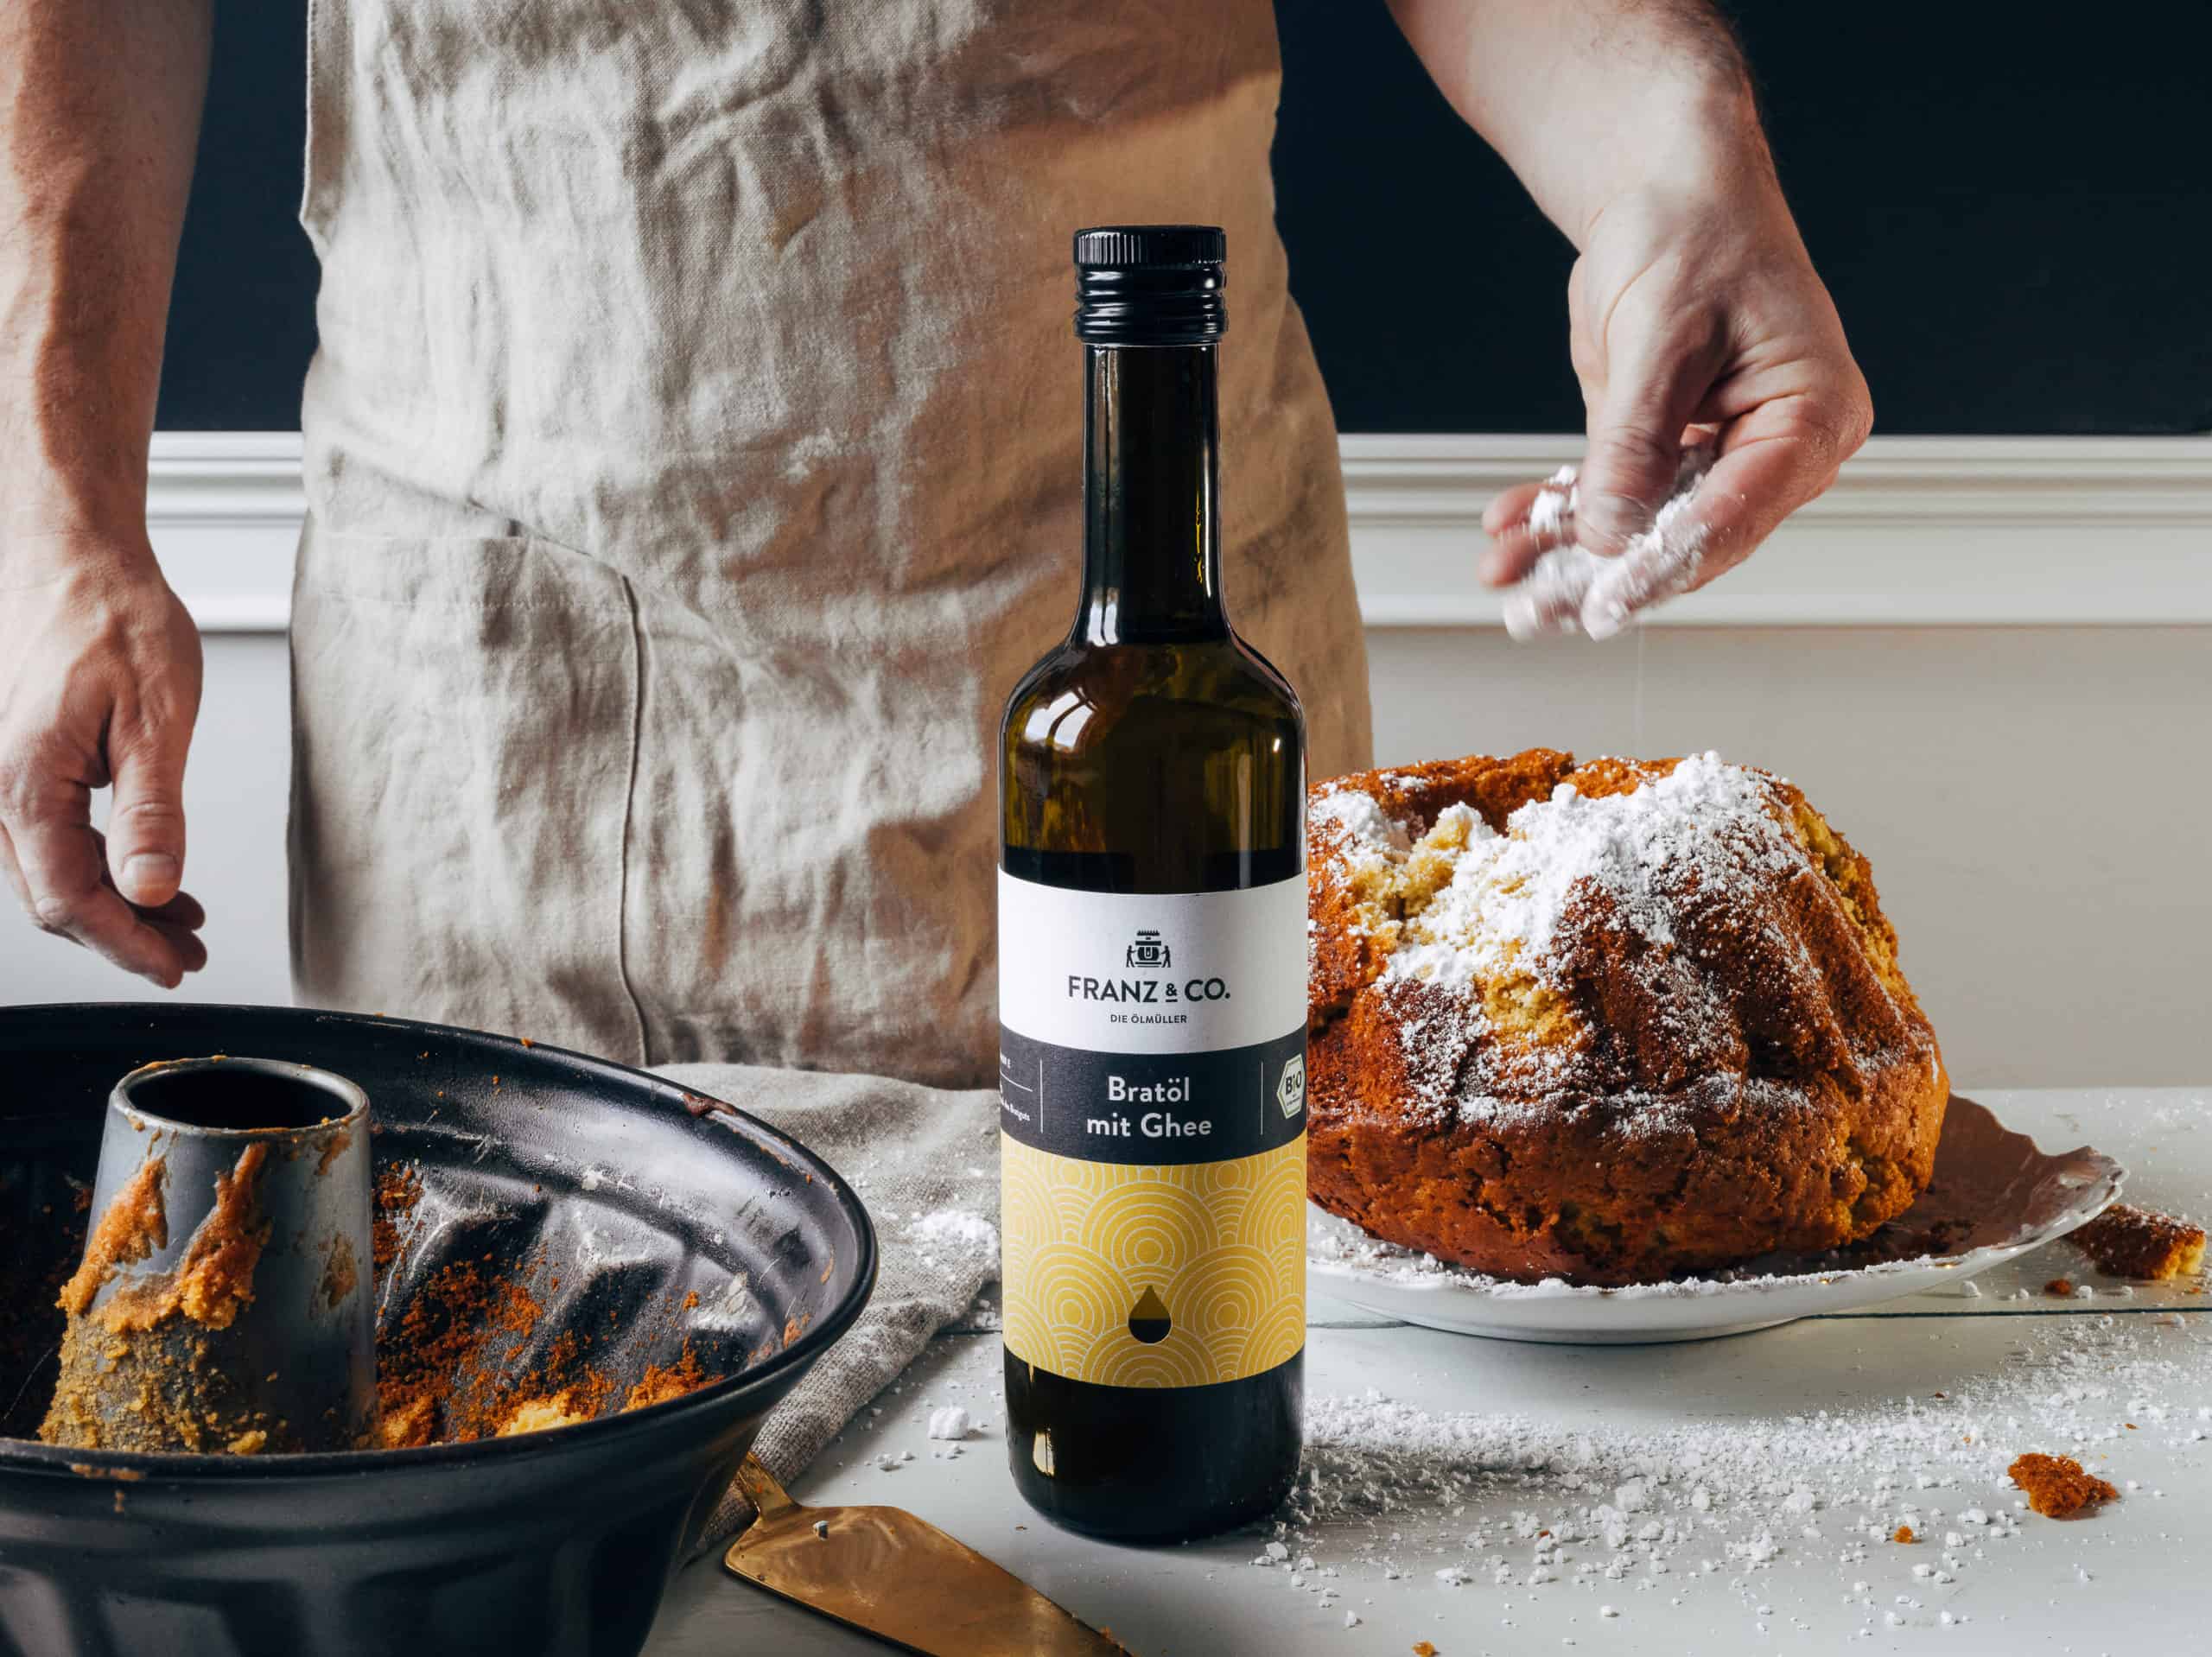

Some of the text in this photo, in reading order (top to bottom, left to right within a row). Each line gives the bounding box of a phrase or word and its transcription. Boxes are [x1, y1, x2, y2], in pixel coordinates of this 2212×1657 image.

[1068, 975, 1230, 1003] FRANZ & CO.
[1109, 1013, 1187, 1025] DIE ÖLMÜLLER
[1108, 1076, 1190, 1102] Bratöl
[1087, 1113, 1212, 1139] mit Ghee
